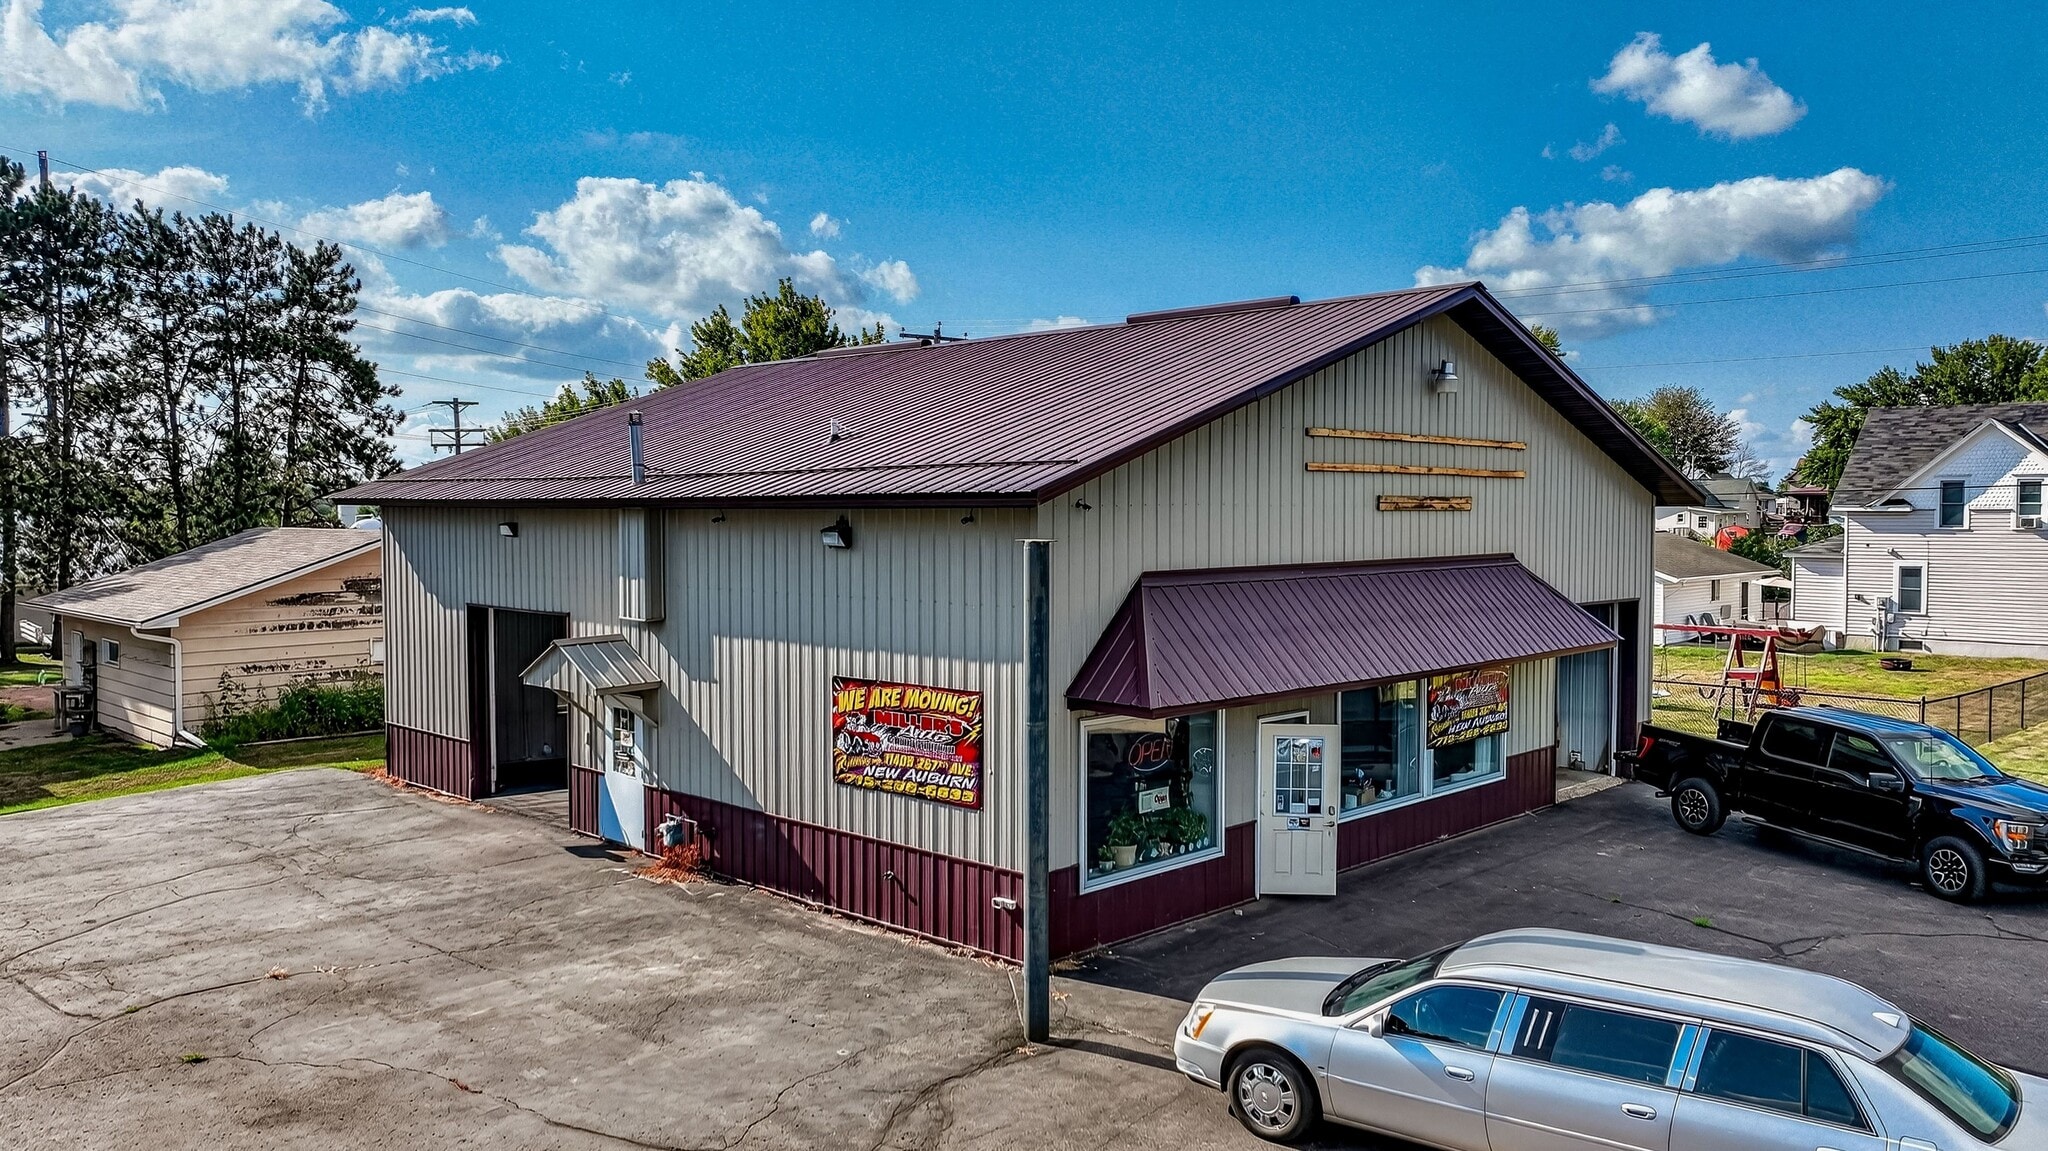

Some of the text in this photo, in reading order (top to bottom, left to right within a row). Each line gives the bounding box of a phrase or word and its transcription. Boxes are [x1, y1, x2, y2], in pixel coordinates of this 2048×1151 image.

[838, 687, 978, 717] WE ARE MOVING!
[863, 765, 976, 790] NEW AUBURN
